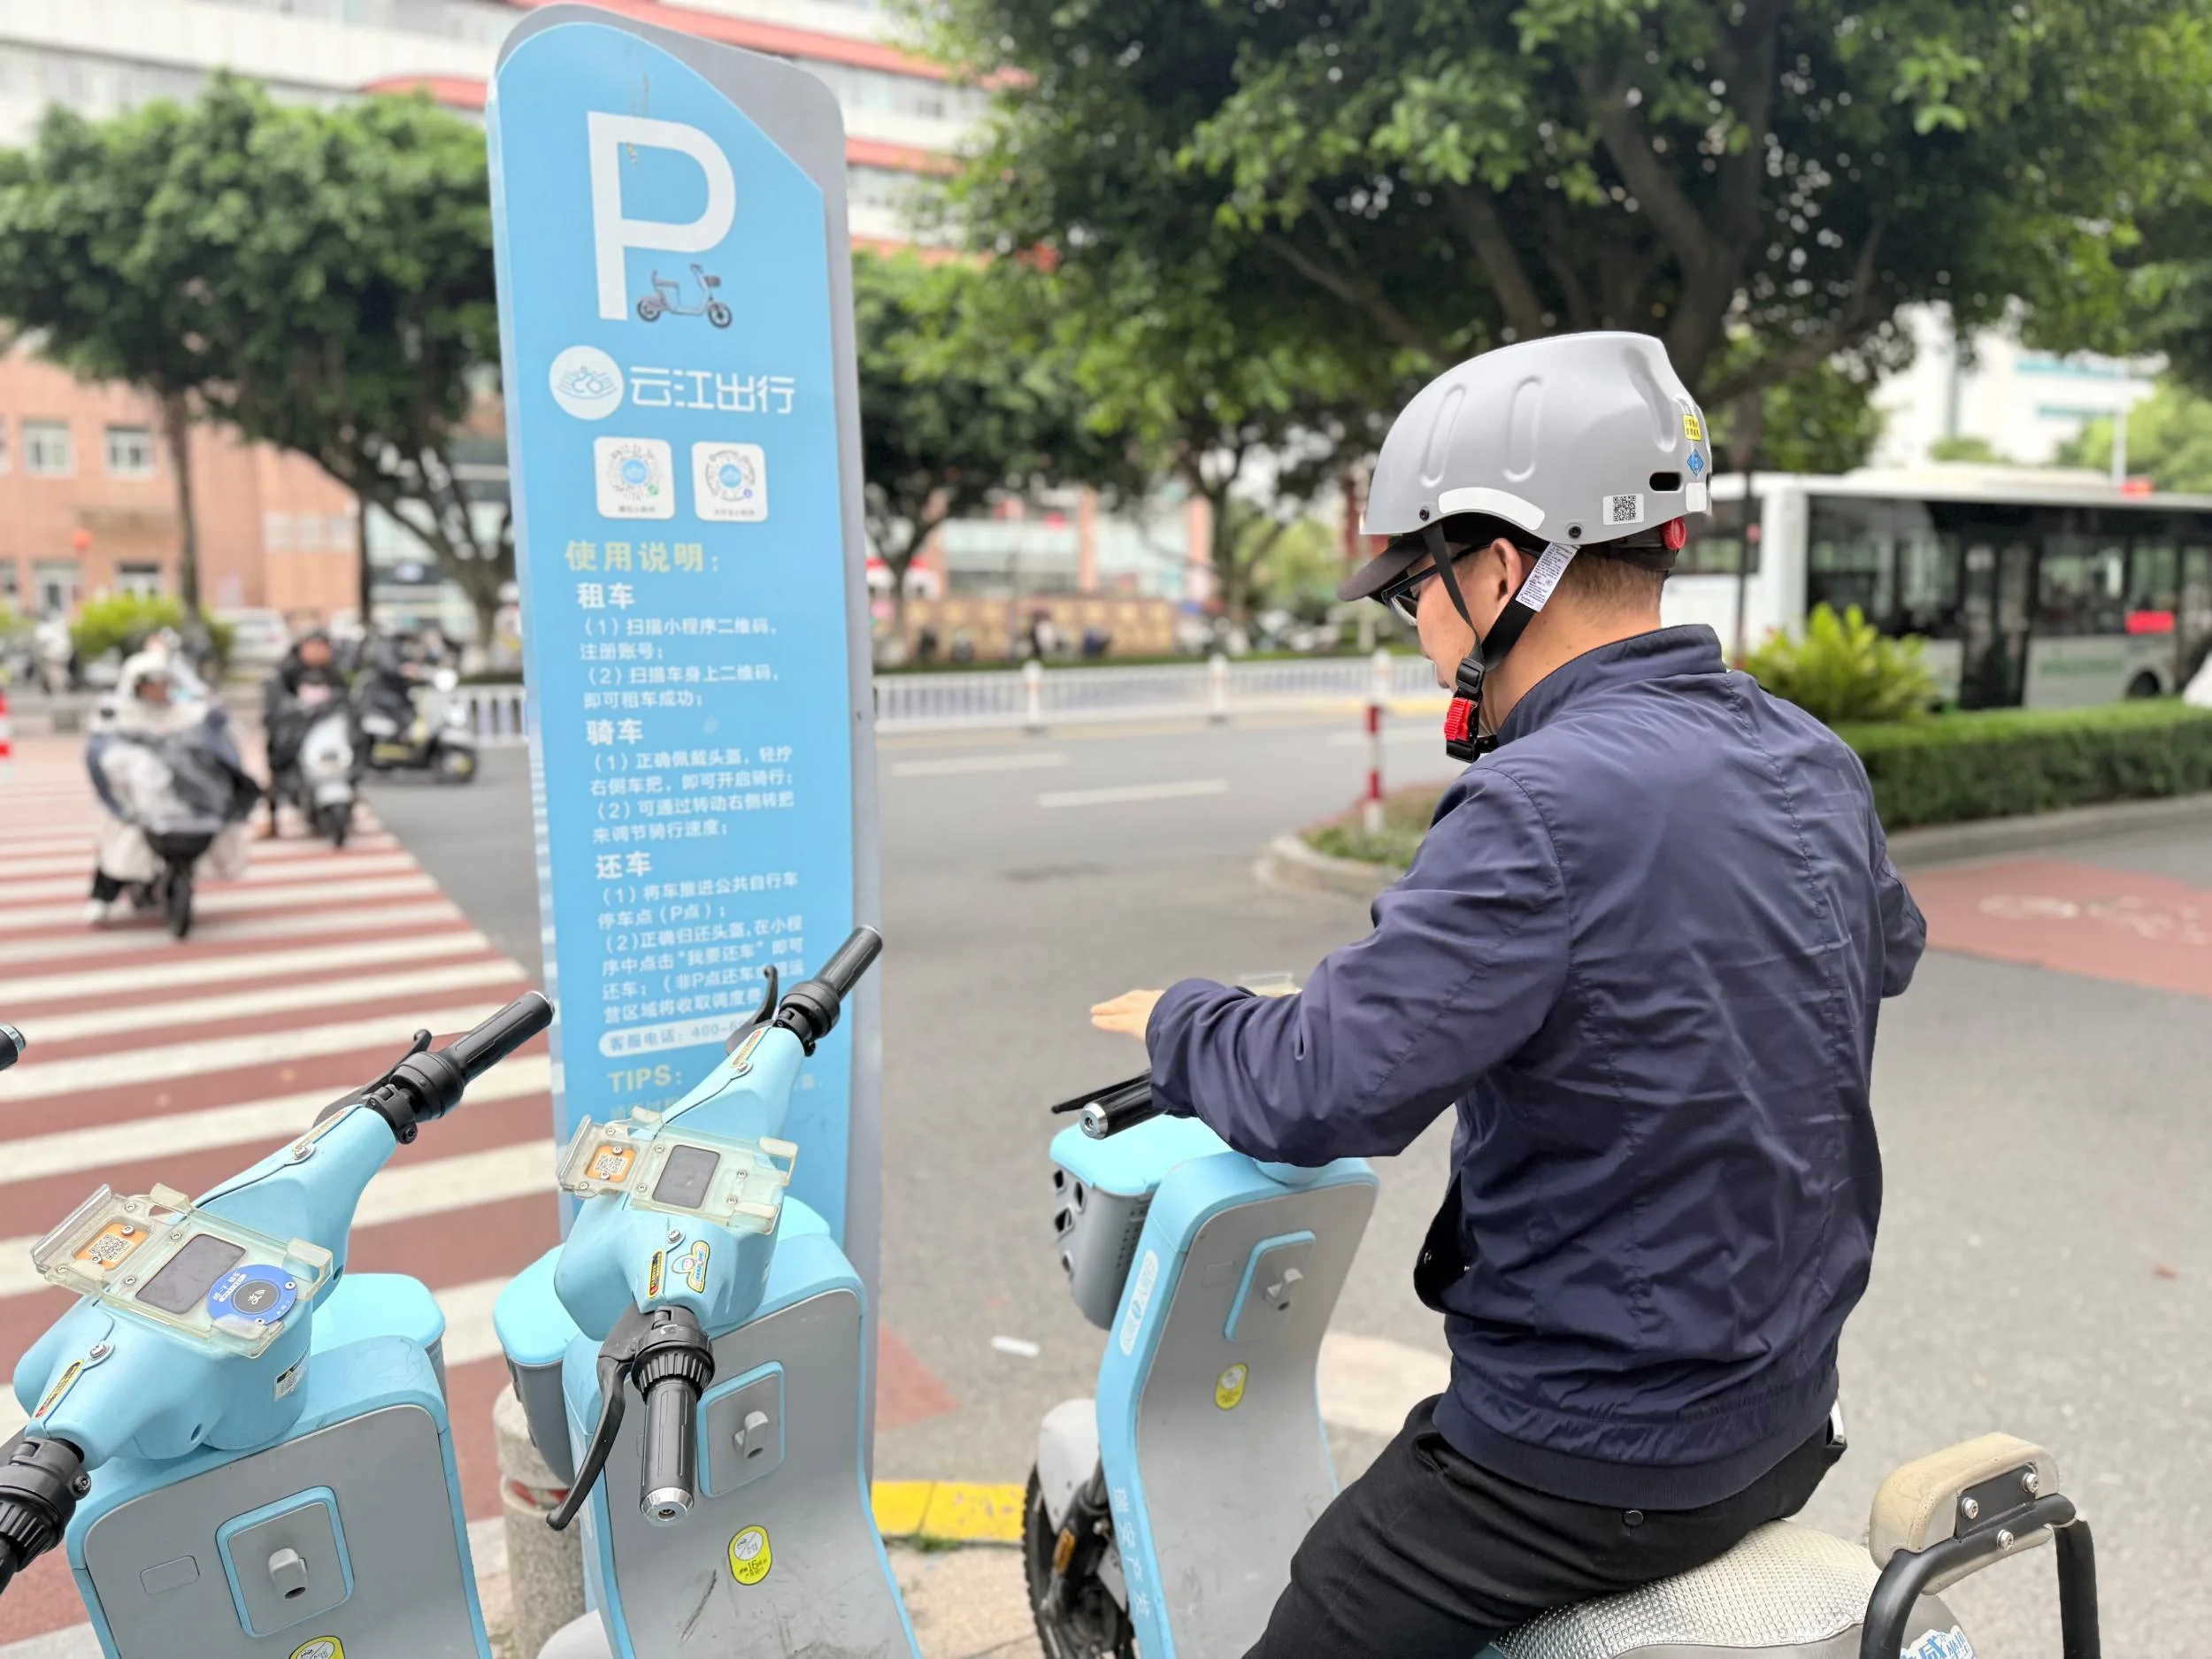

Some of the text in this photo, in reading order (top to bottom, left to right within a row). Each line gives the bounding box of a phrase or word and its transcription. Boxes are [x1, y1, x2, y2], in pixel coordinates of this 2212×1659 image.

[588, 111, 736, 320] P
[630, 366, 795, 414] 云江出行
[577, 582, 634, 610] 租车
[585, 718, 643, 746] 骑车
[595, 850, 652, 879] 还车
